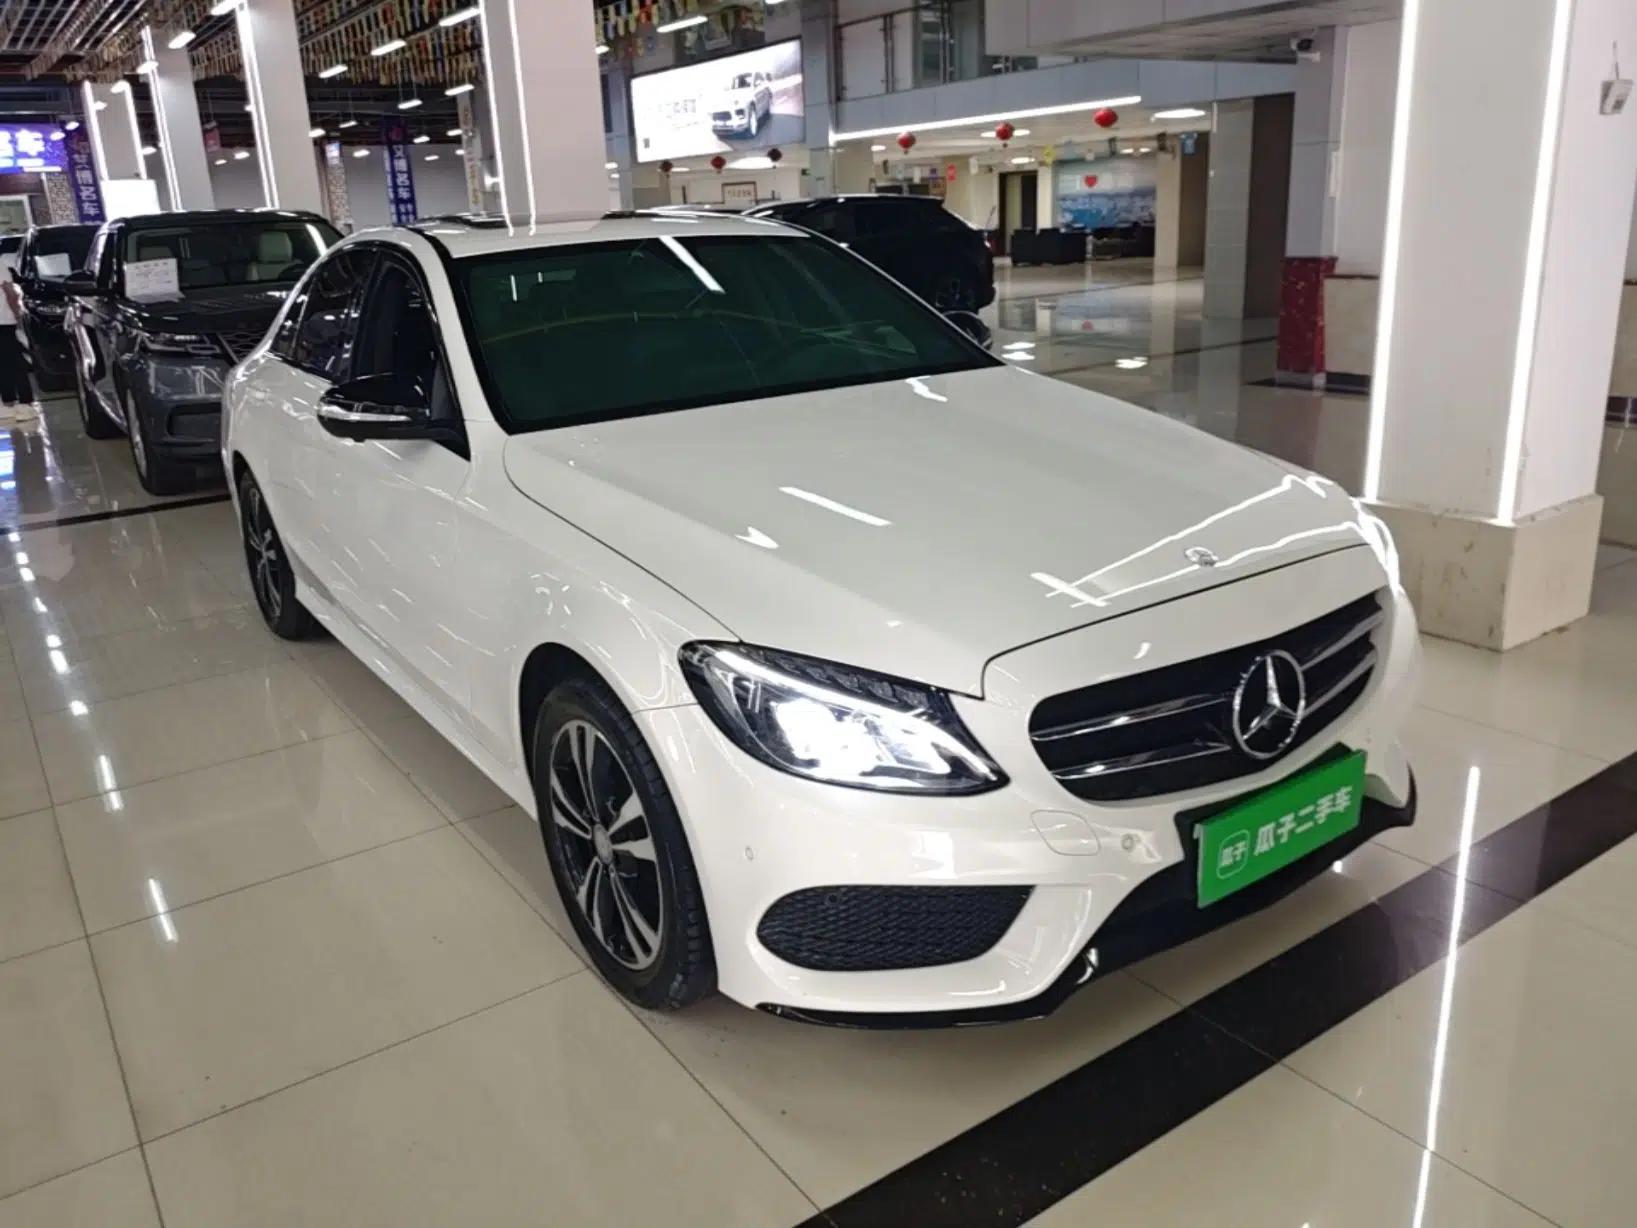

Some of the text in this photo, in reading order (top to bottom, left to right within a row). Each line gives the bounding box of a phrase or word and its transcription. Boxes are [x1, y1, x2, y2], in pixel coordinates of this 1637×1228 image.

[1253, 785, 1353, 857] 瓜子二手车
